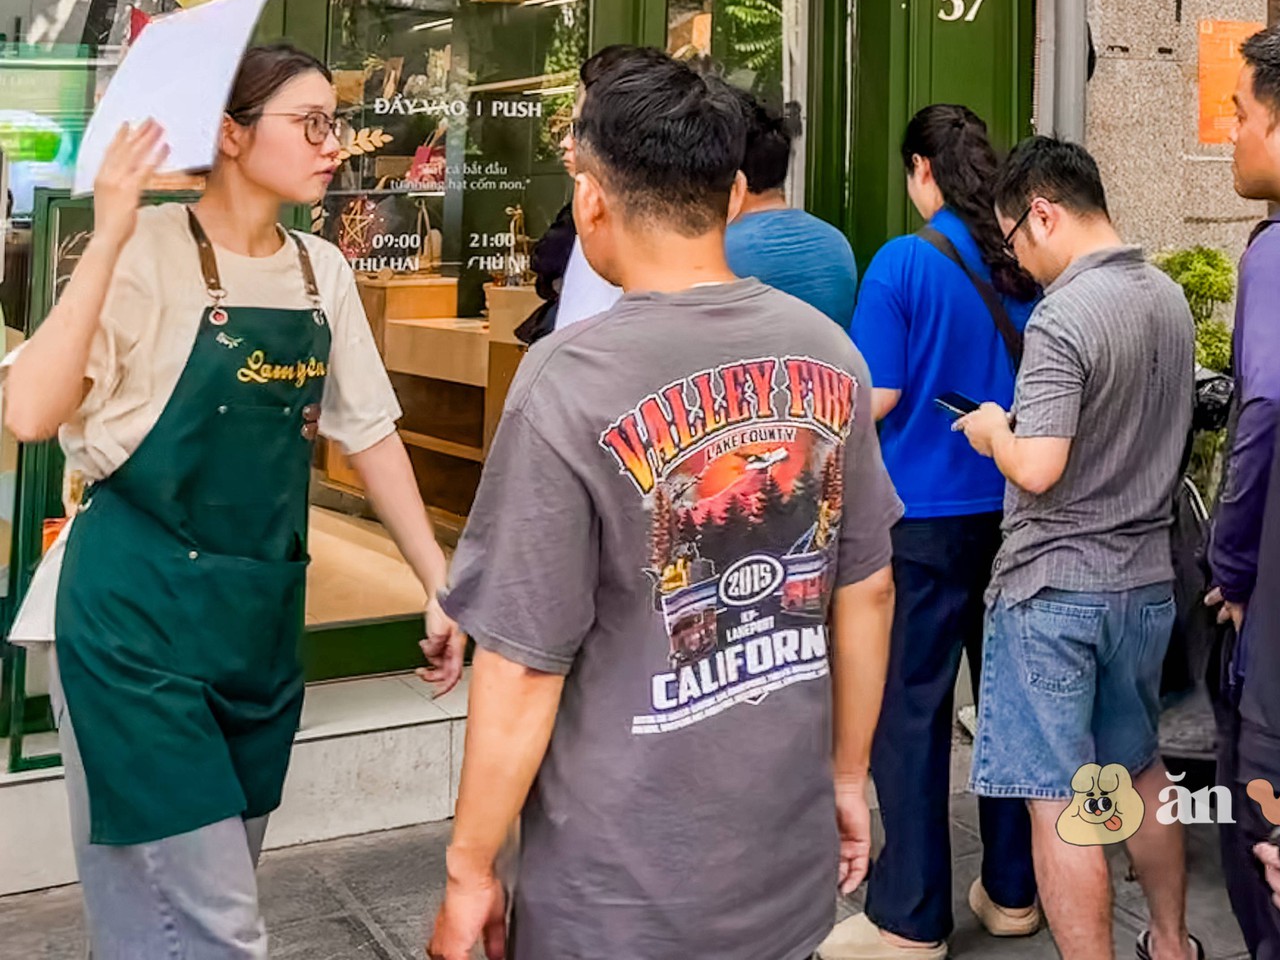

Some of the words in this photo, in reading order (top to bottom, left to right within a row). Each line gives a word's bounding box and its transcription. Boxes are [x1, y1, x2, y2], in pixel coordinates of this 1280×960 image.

[491, 101, 542, 117] PUSH
[372, 233, 421, 250] 09:00
[469, 232, 516, 249] 21:00
[599, 356, 778, 497] VALLEY
[727, 563, 772, 597] 2015
[651, 625, 829, 711] CALIFORN
